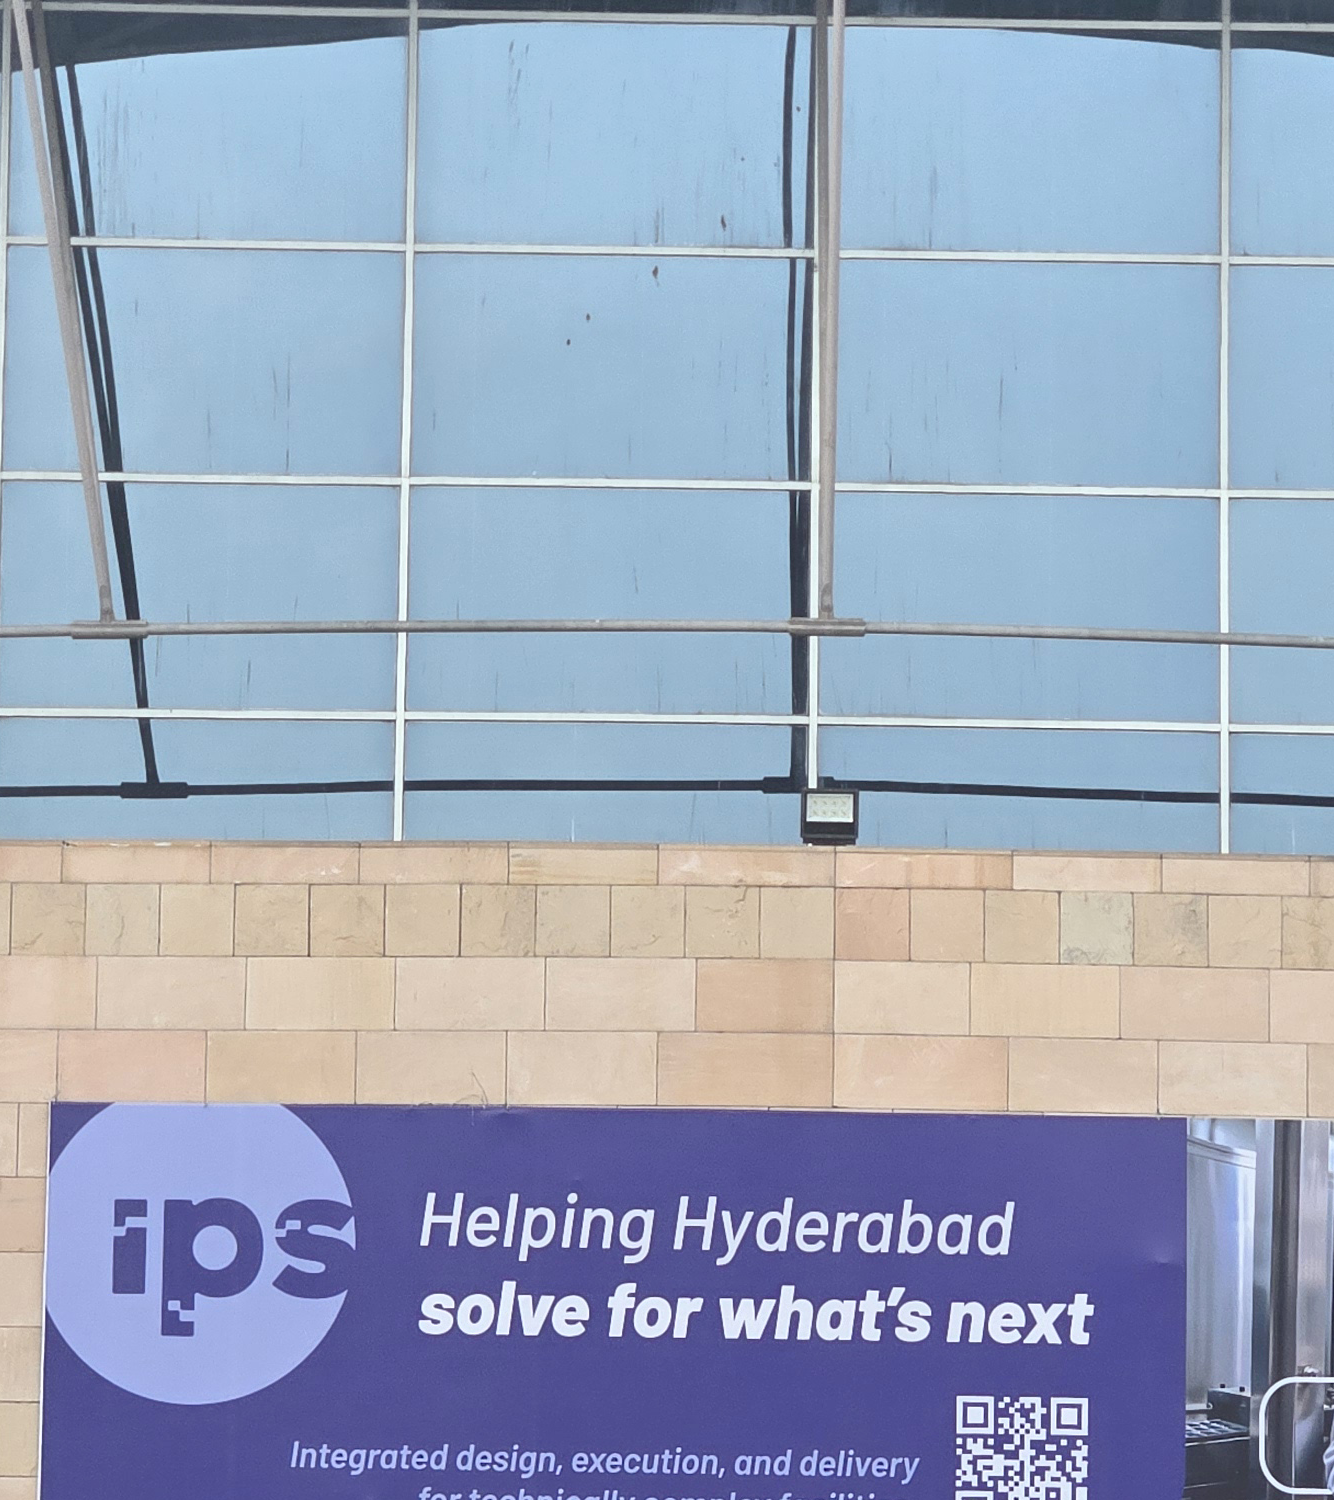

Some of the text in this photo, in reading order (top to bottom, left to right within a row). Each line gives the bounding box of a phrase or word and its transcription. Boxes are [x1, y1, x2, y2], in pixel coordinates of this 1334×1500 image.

[420, 1193, 1015, 1265] Helping Hyderabad
[112, 1198, 357, 1337] ips
[419, 1281, 589, 1337] solve
[608, 1283, 697, 1338] for
[947, 1294, 1094, 1344] next
[291, 1441, 919, 1484] Integrated design, execution, and delivery
